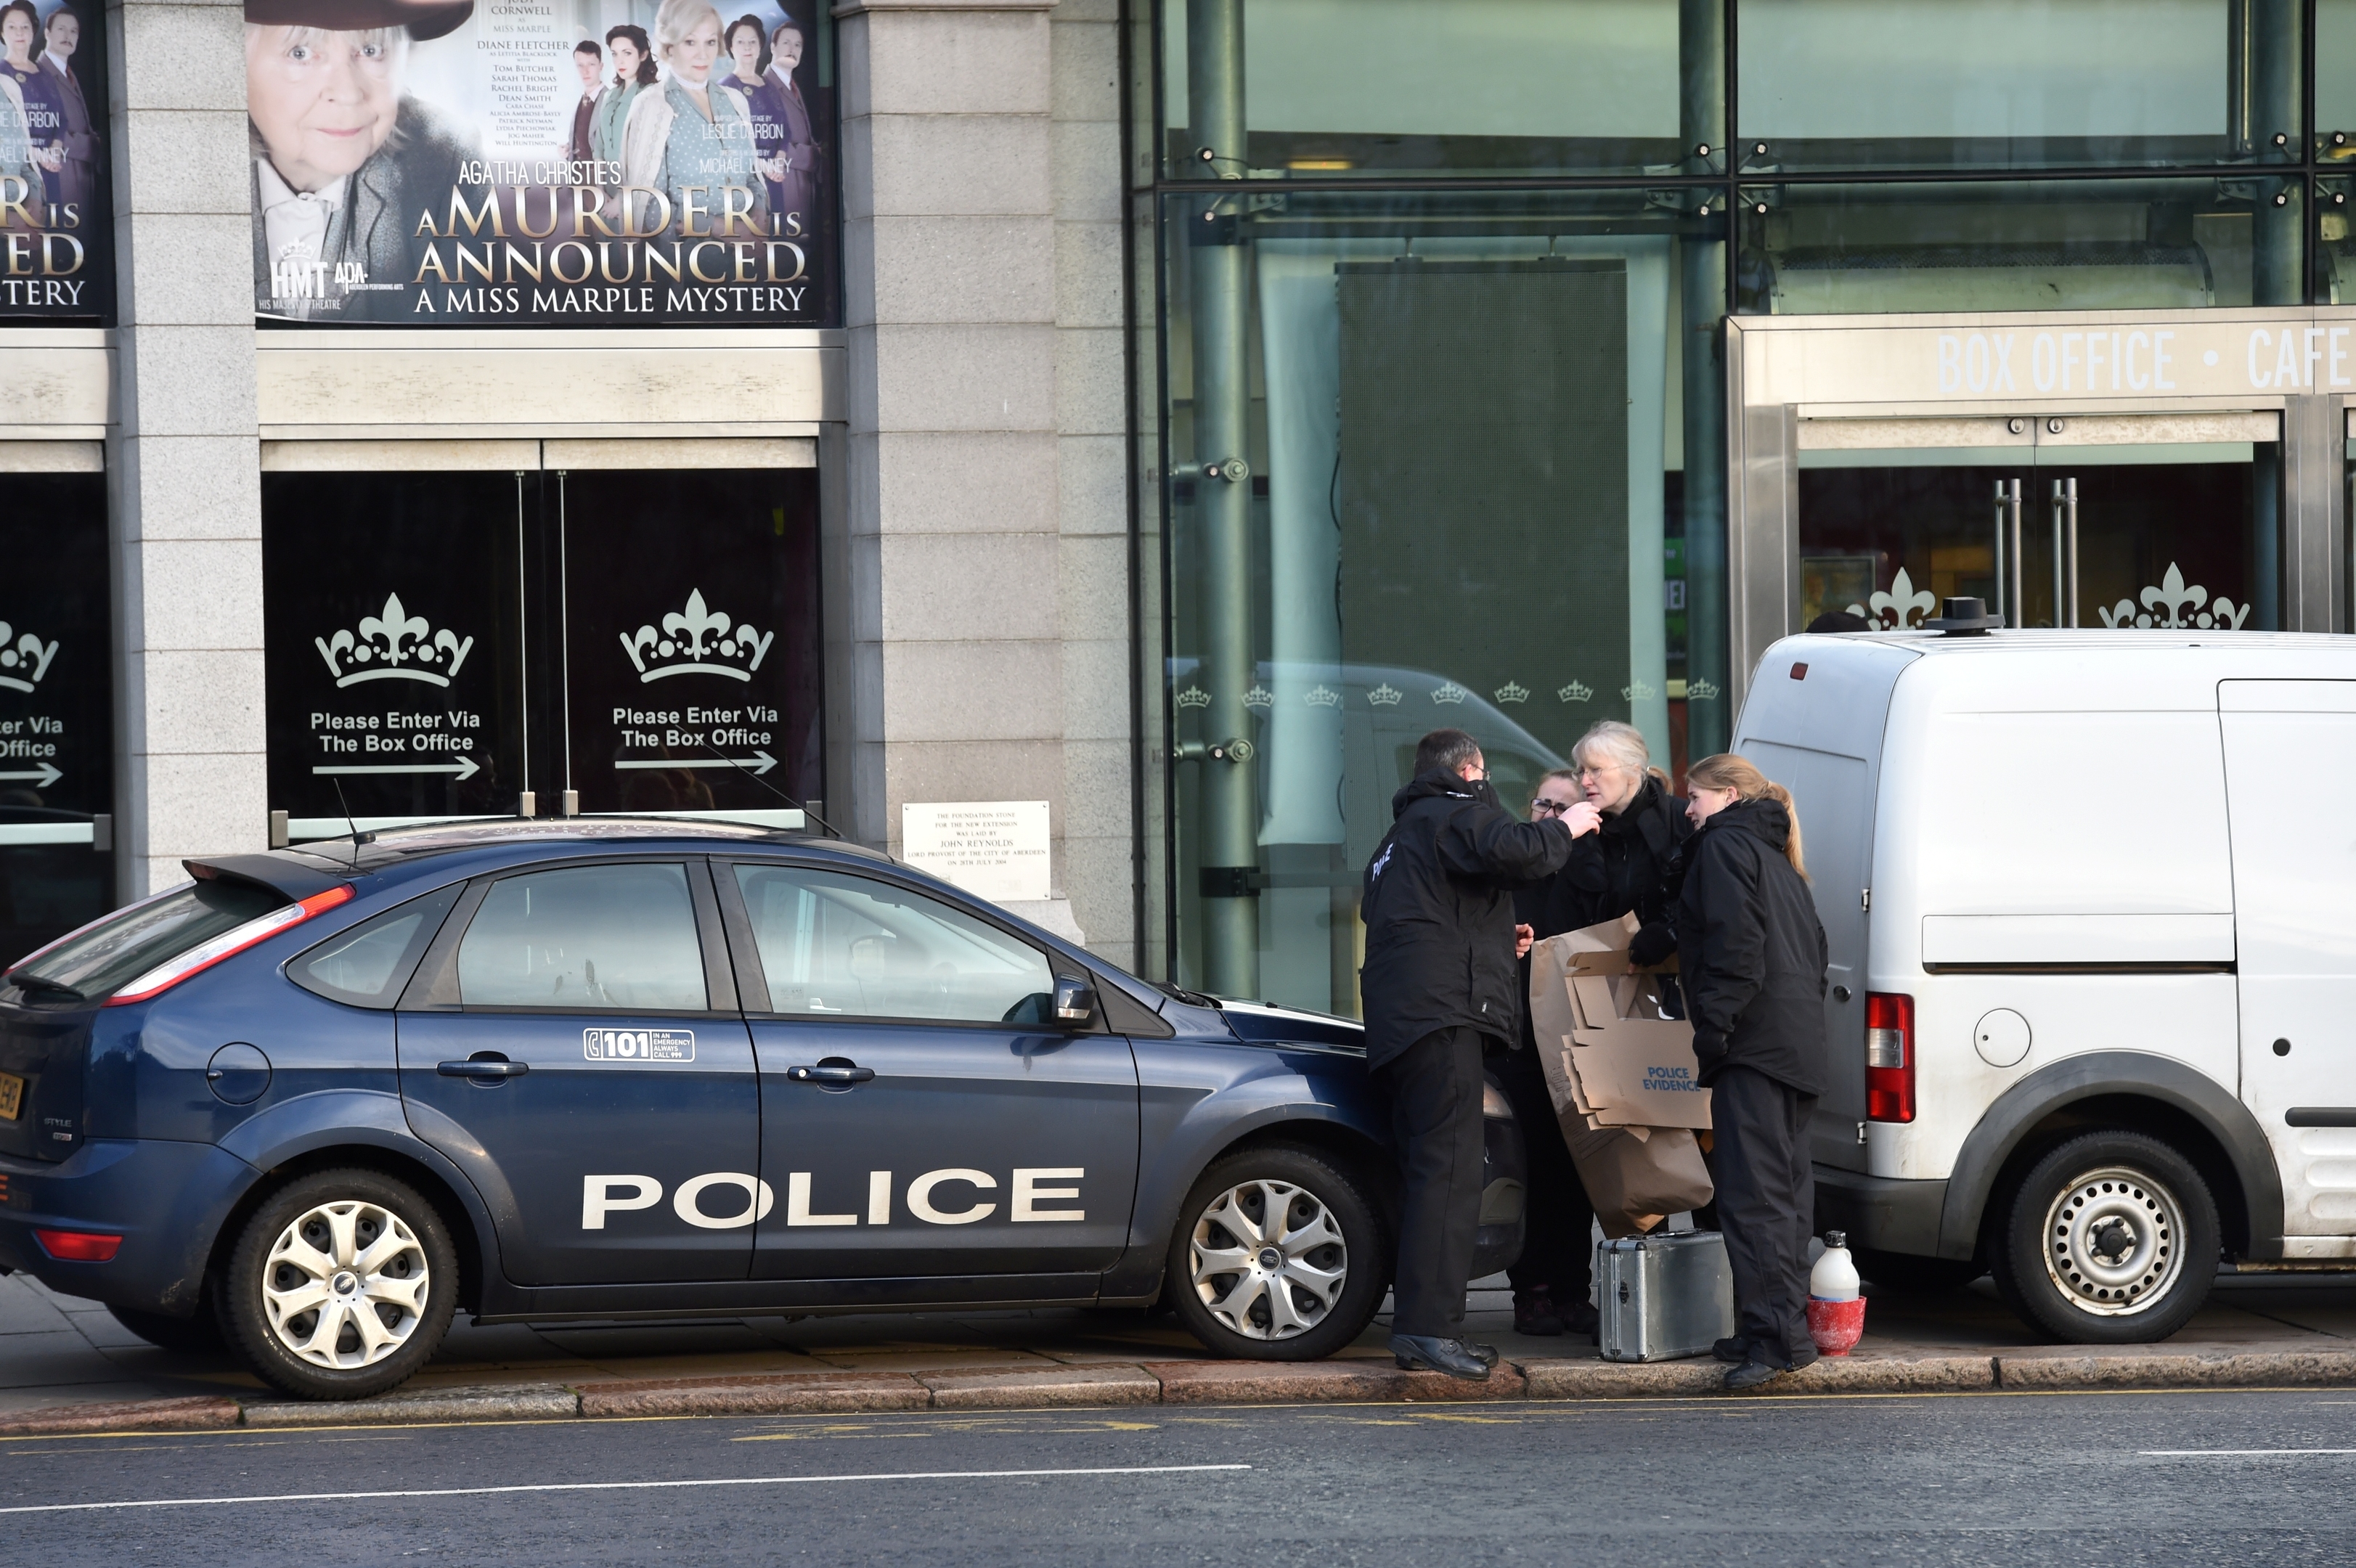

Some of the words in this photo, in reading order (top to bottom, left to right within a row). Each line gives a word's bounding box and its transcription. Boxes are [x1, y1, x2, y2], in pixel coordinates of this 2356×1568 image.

[491, 6, 552, 15] CORNWELL
[477, 41, 512, 49] DIANE
[515, 41, 569, 49] FLETCHER
[13, 111, 60, 128] DARBON
[702, 123, 736, 139] LESLIE
[740, 123, 784, 139] DARBON
[23, 147, 69, 163] LUNNEY
[458, 160, 529, 185] AGATHA
[535, 160, 621, 185] CHRISTIE'S
[699, 158, 746, 174] MICHAEL
[749, 158, 793, 174] LUNNEY
[48, 203, 80, 229] IS
[413, 208, 443, 237] A
[443, 184, 770, 238] MURDER
[772, 212, 802, 237] IS
[411, 241, 806, 284] ANNOUNCED
[270, 261, 327, 298] HMT
[258, 299, 271, 310] HIS
[311, 299, 341, 310] THEATRE
[413, 287, 437, 313] A
[444, 287, 520, 313] MISS
[531, 287, 655, 313] MARPLE
[665, 287, 807, 312] MYSTERY
[1938, 333, 2016, 393] BOX
[2032, 331, 2175, 392] OFFICE
[2247, 327, 2351, 389] CAFE
[311, 711, 380, 730] Please
[387, 711, 442, 728] Enter
[448, 711, 481, 728] Via
[613, 707, 680, 725] Please
[687, 706, 741, 724] Enter
[746, 705, 778, 723] Via
[29, 716, 63, 734] Via
[319, 735, 358, 752] The
[365, 734, 406, 751] Box
[412, 733, 473, 751] Office
[621, 730, 659, 748] The
[666, 729, 705, 747] Box
[712, 728, 772, 746] Office
[940, 840, 963, 849] JOHN
[967, 839, 1014, 848] REYNOLDS
[604, 1032, 649, 1058] 101
[1647, 1066, 1689, 1079] POLICE
[1642, 1079, 1701, 1092] EVIDENCE
[44, 1117, 72, 1127] STYLE
[582, 1167, 1085, 1230] POLICE
